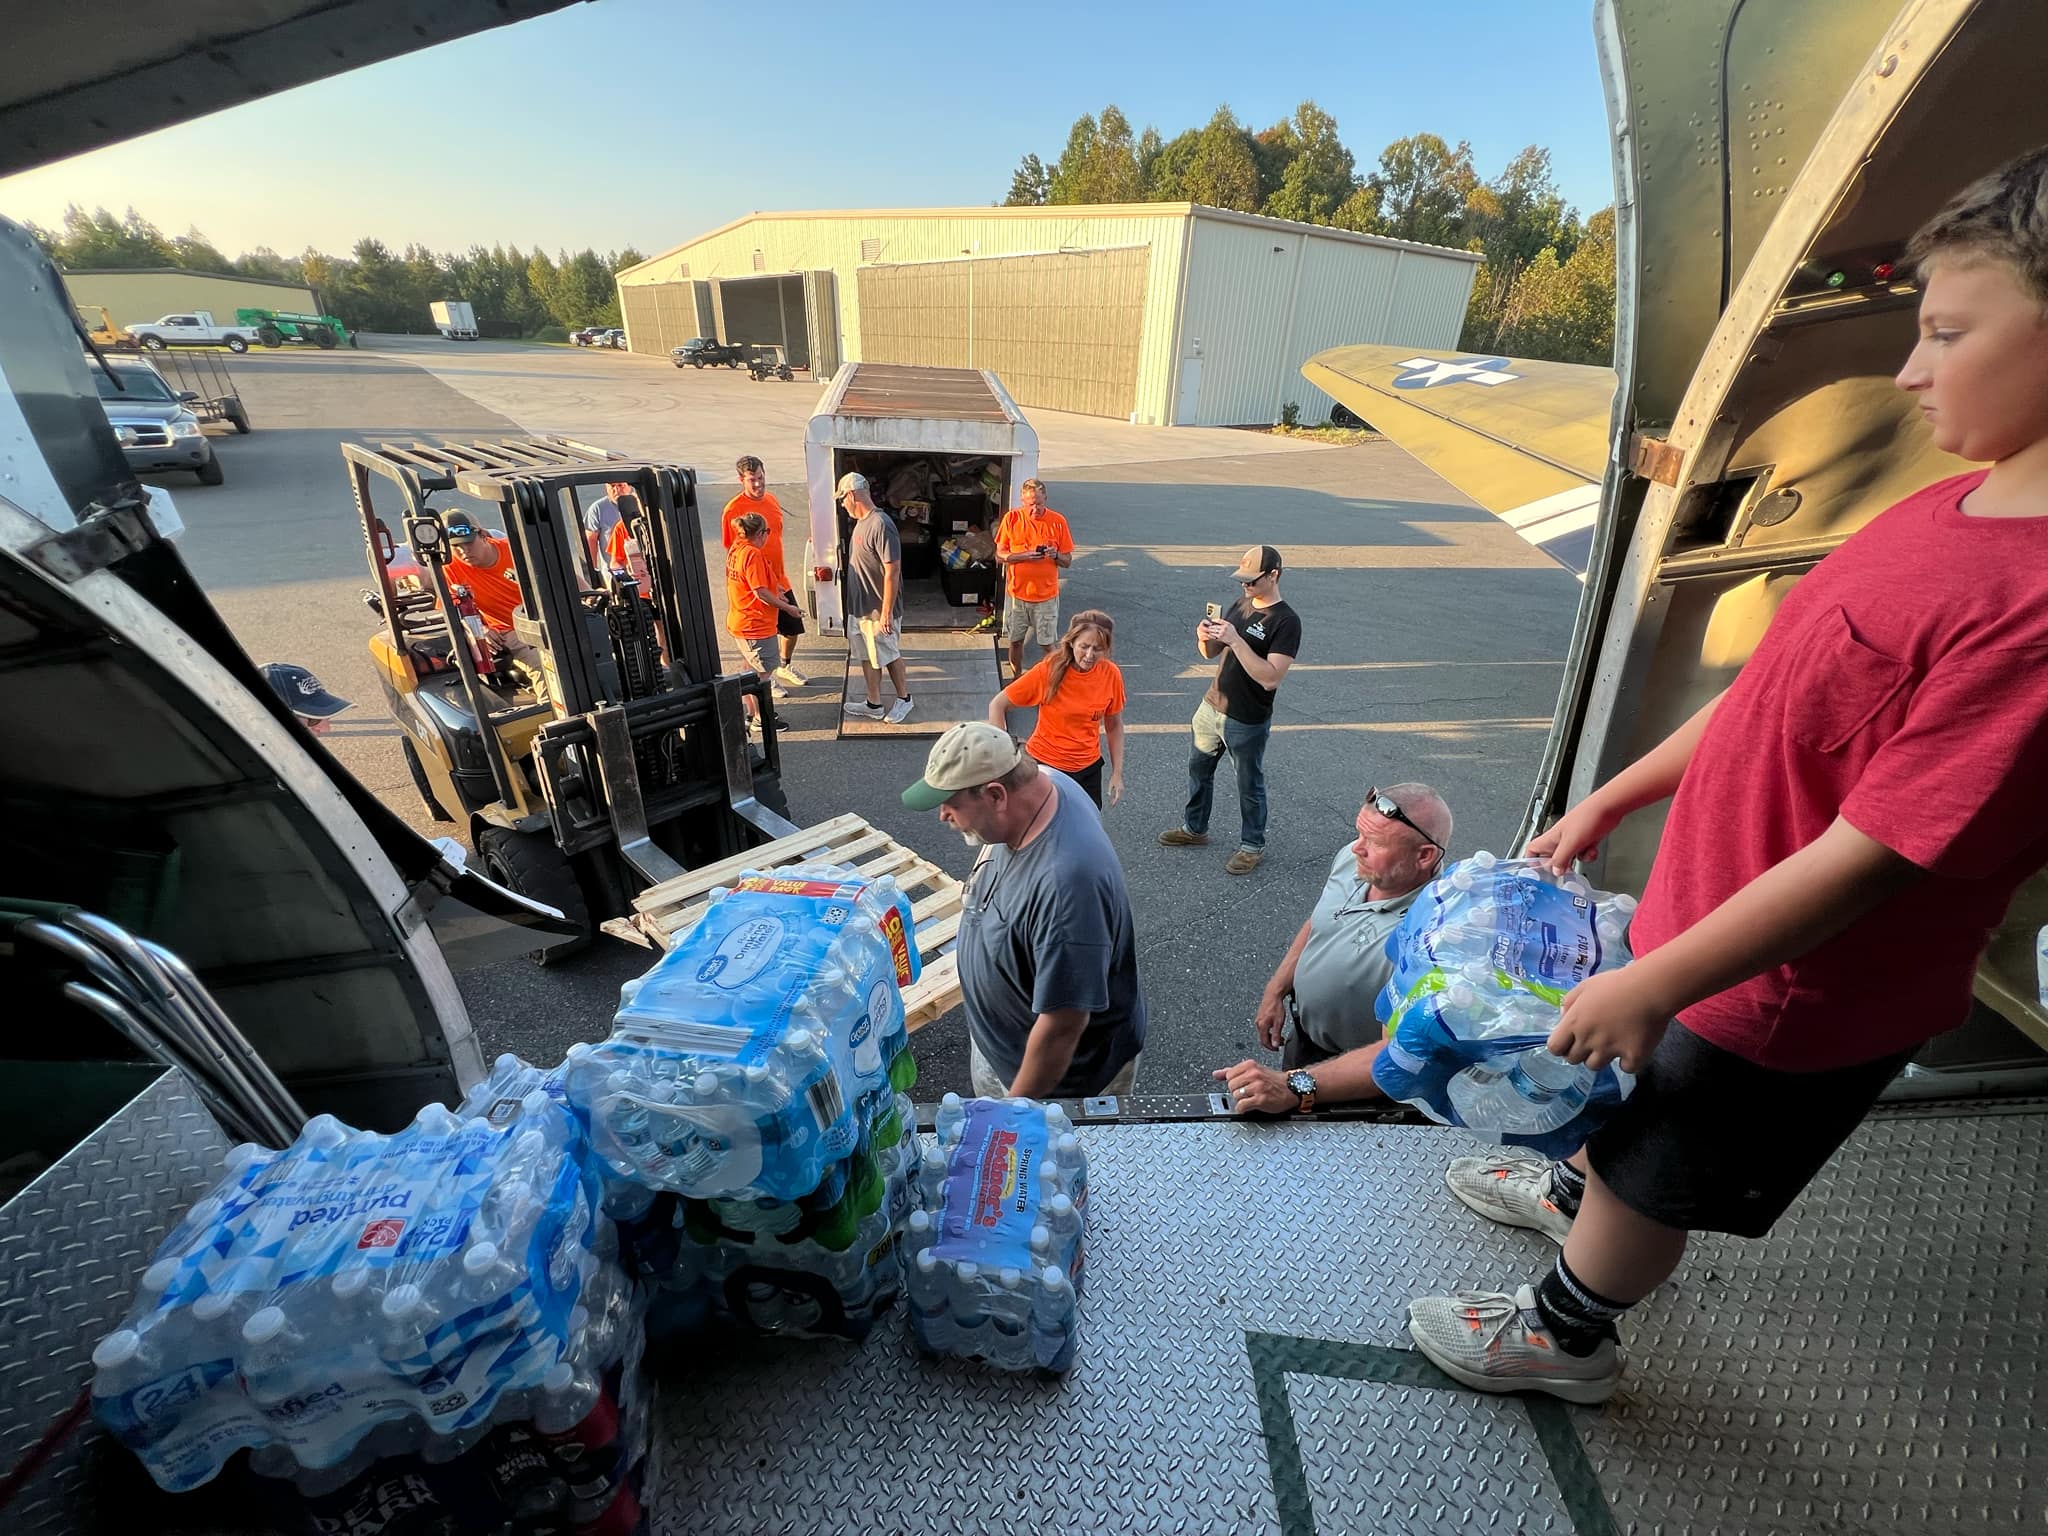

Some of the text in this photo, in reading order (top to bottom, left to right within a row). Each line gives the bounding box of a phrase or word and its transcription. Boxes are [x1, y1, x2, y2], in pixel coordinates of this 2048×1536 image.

[768, 886, 803, 895] PACK
[773, 880, 808, 889] VALUE
[734, 924, 768, 960] Drinking
[750, 924, 776, 950] Water
[897, 943, 910, 976] VALUE
[982, 1129, 1018, 1227] Redner's
[1015, 1147, 1033, 1213] SPRING WATER
[318, 1183, 398, 1204] drinking
[287, 1189, 413, 1232] purified
[413, 1224, 449, 1247] 24
